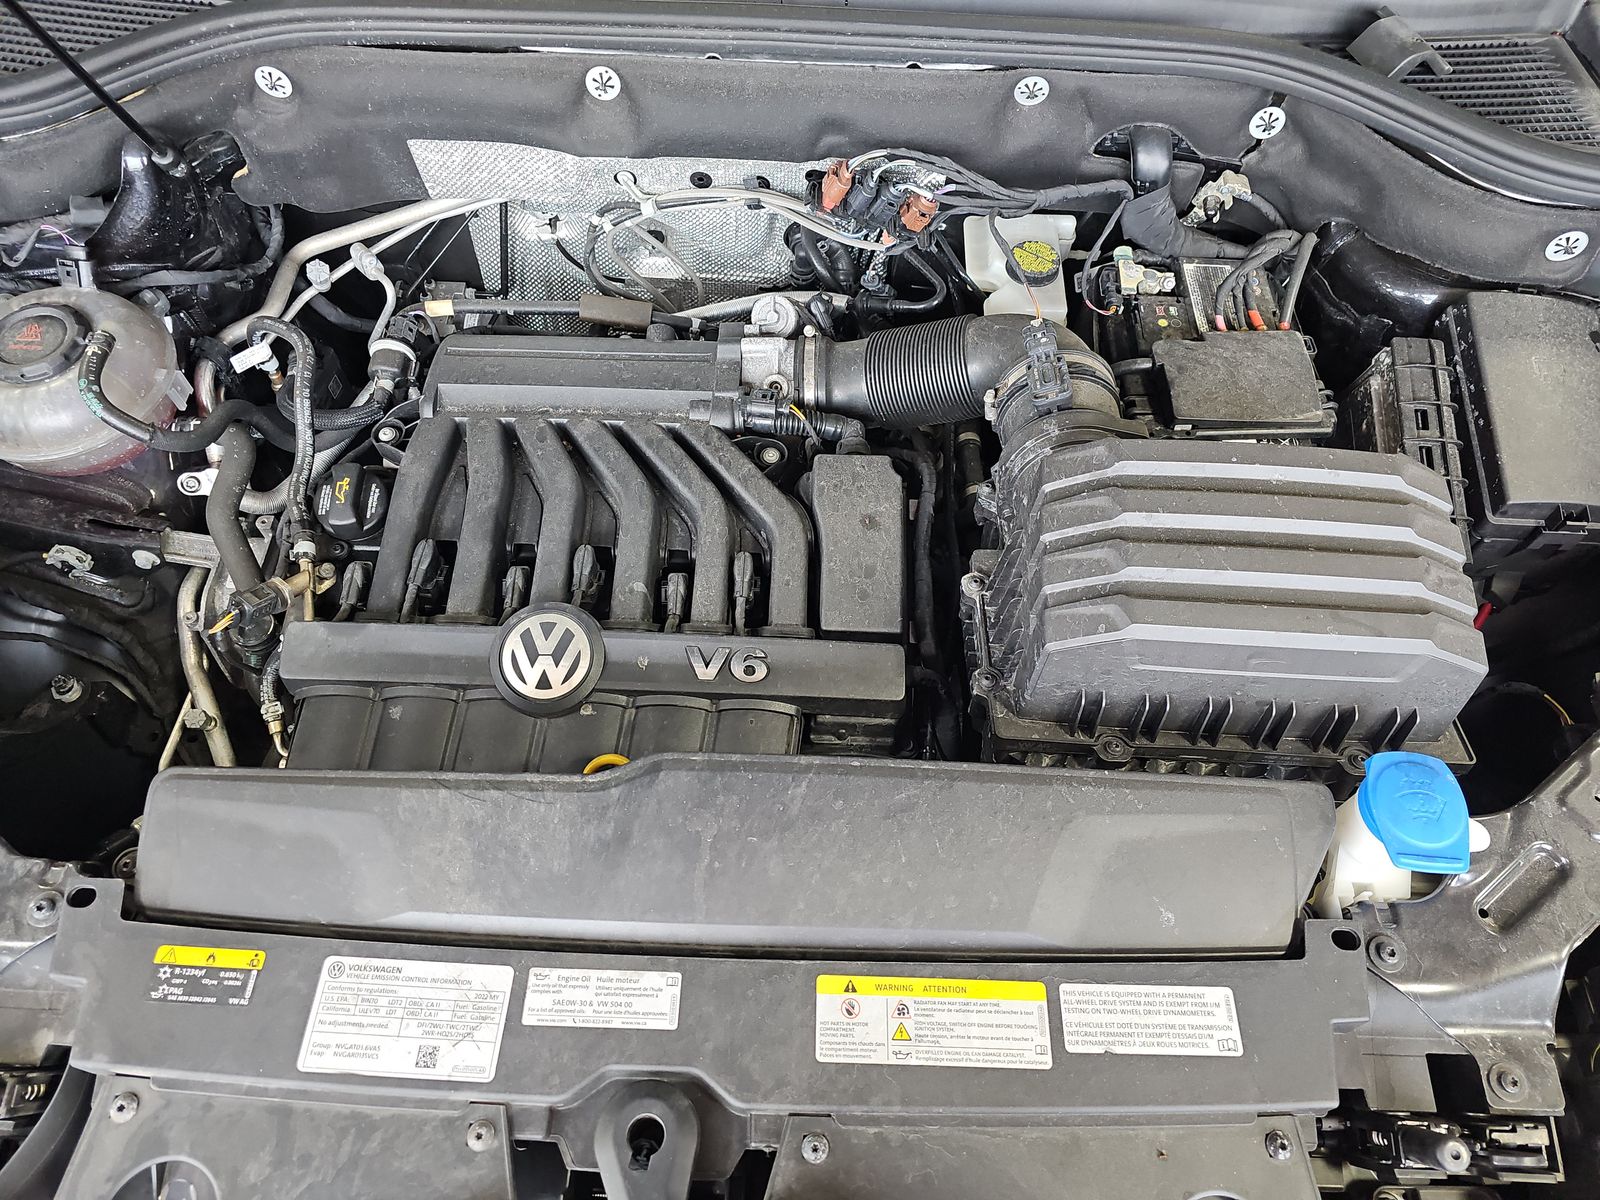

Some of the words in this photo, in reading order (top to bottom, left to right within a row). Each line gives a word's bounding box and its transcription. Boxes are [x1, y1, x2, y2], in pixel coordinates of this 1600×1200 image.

[684, 646, 770, 682] V6
[174, 967, 207, 977] R-1234yf
[348, 964, 402, 974] VOLKSWAGEN
[558, 975, 580, 983] Engine
[875, 983, 913, 992] WARNING
[923, 985, 967, 993] ATTENTION
[328, 1020, 364, 1028] adjustments
